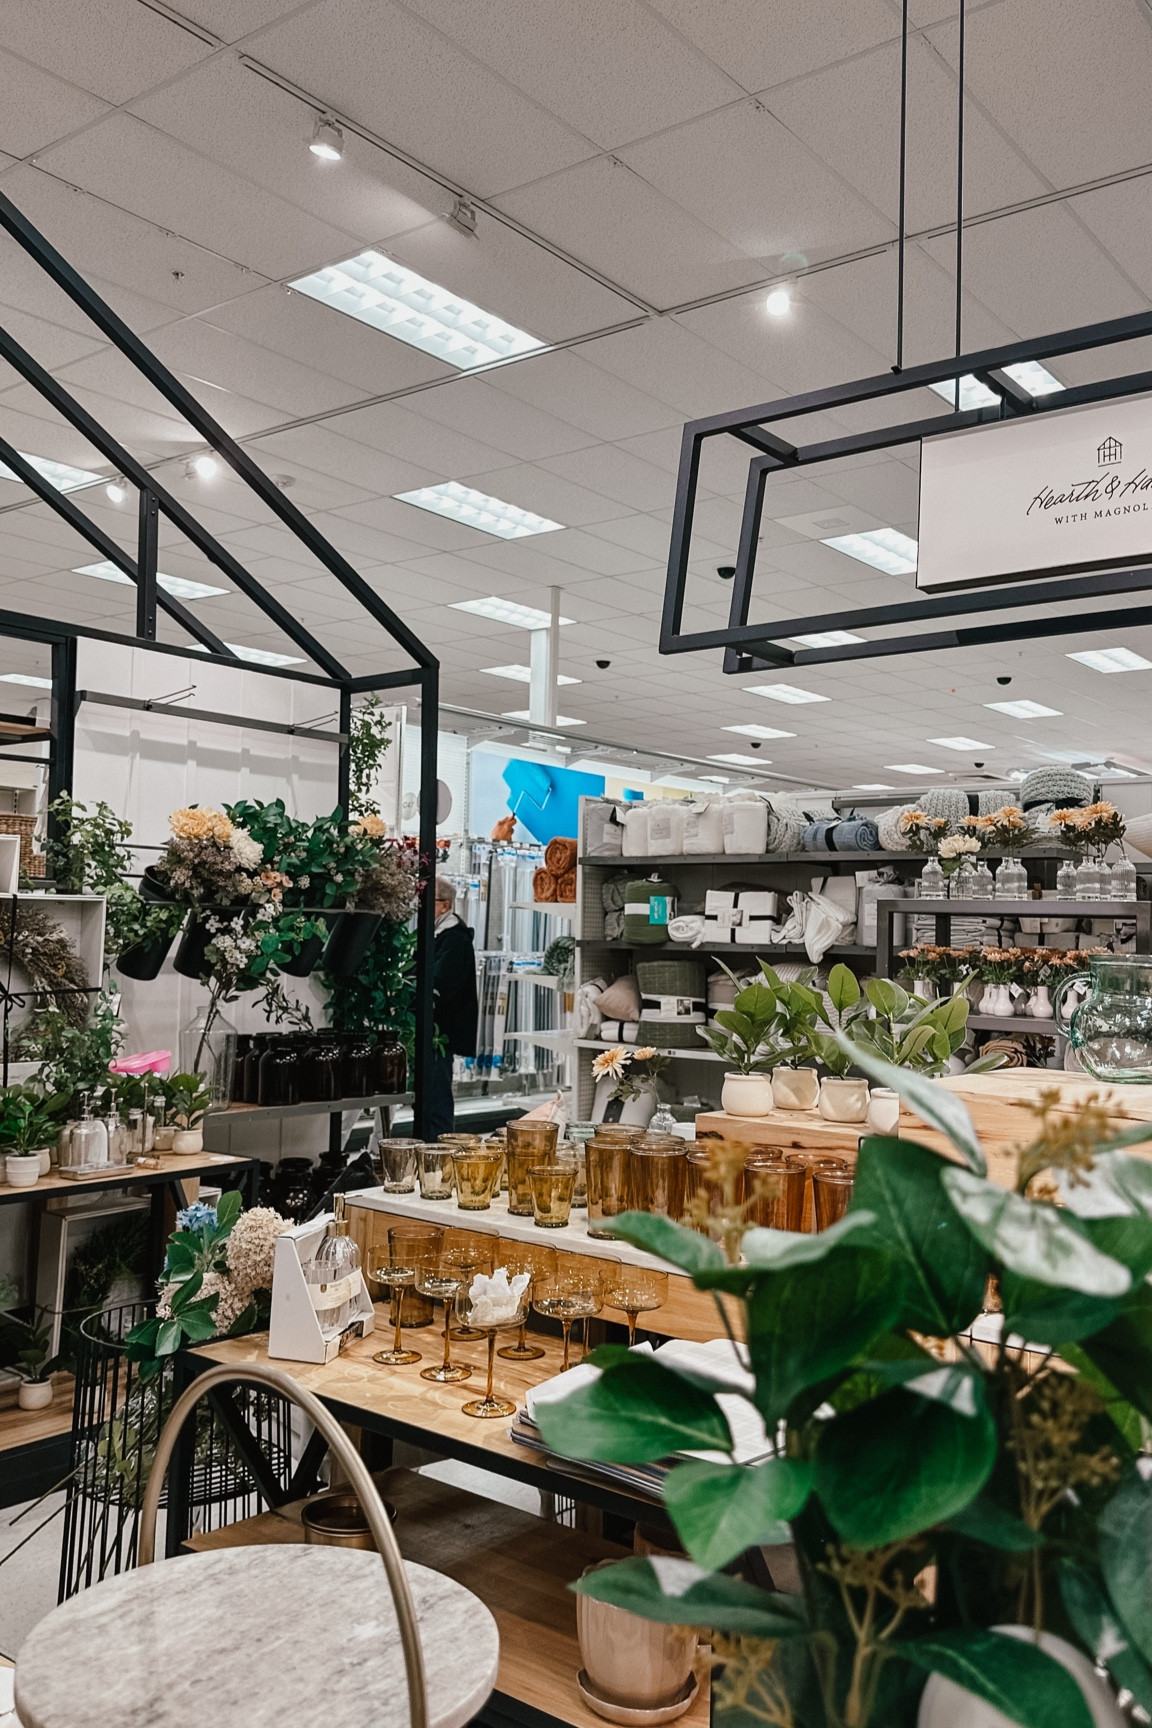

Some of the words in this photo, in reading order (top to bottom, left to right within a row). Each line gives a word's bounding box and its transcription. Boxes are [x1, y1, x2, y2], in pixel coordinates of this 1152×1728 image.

[1027, 472, 1110, 515] Hearth
[1104, 475, 1121, 500] &
[1119, 468, 1152, 498] Ha
[1054, 512, 1087, 525] WITH
[1094, 503, 1152, 519] MAGNOL
